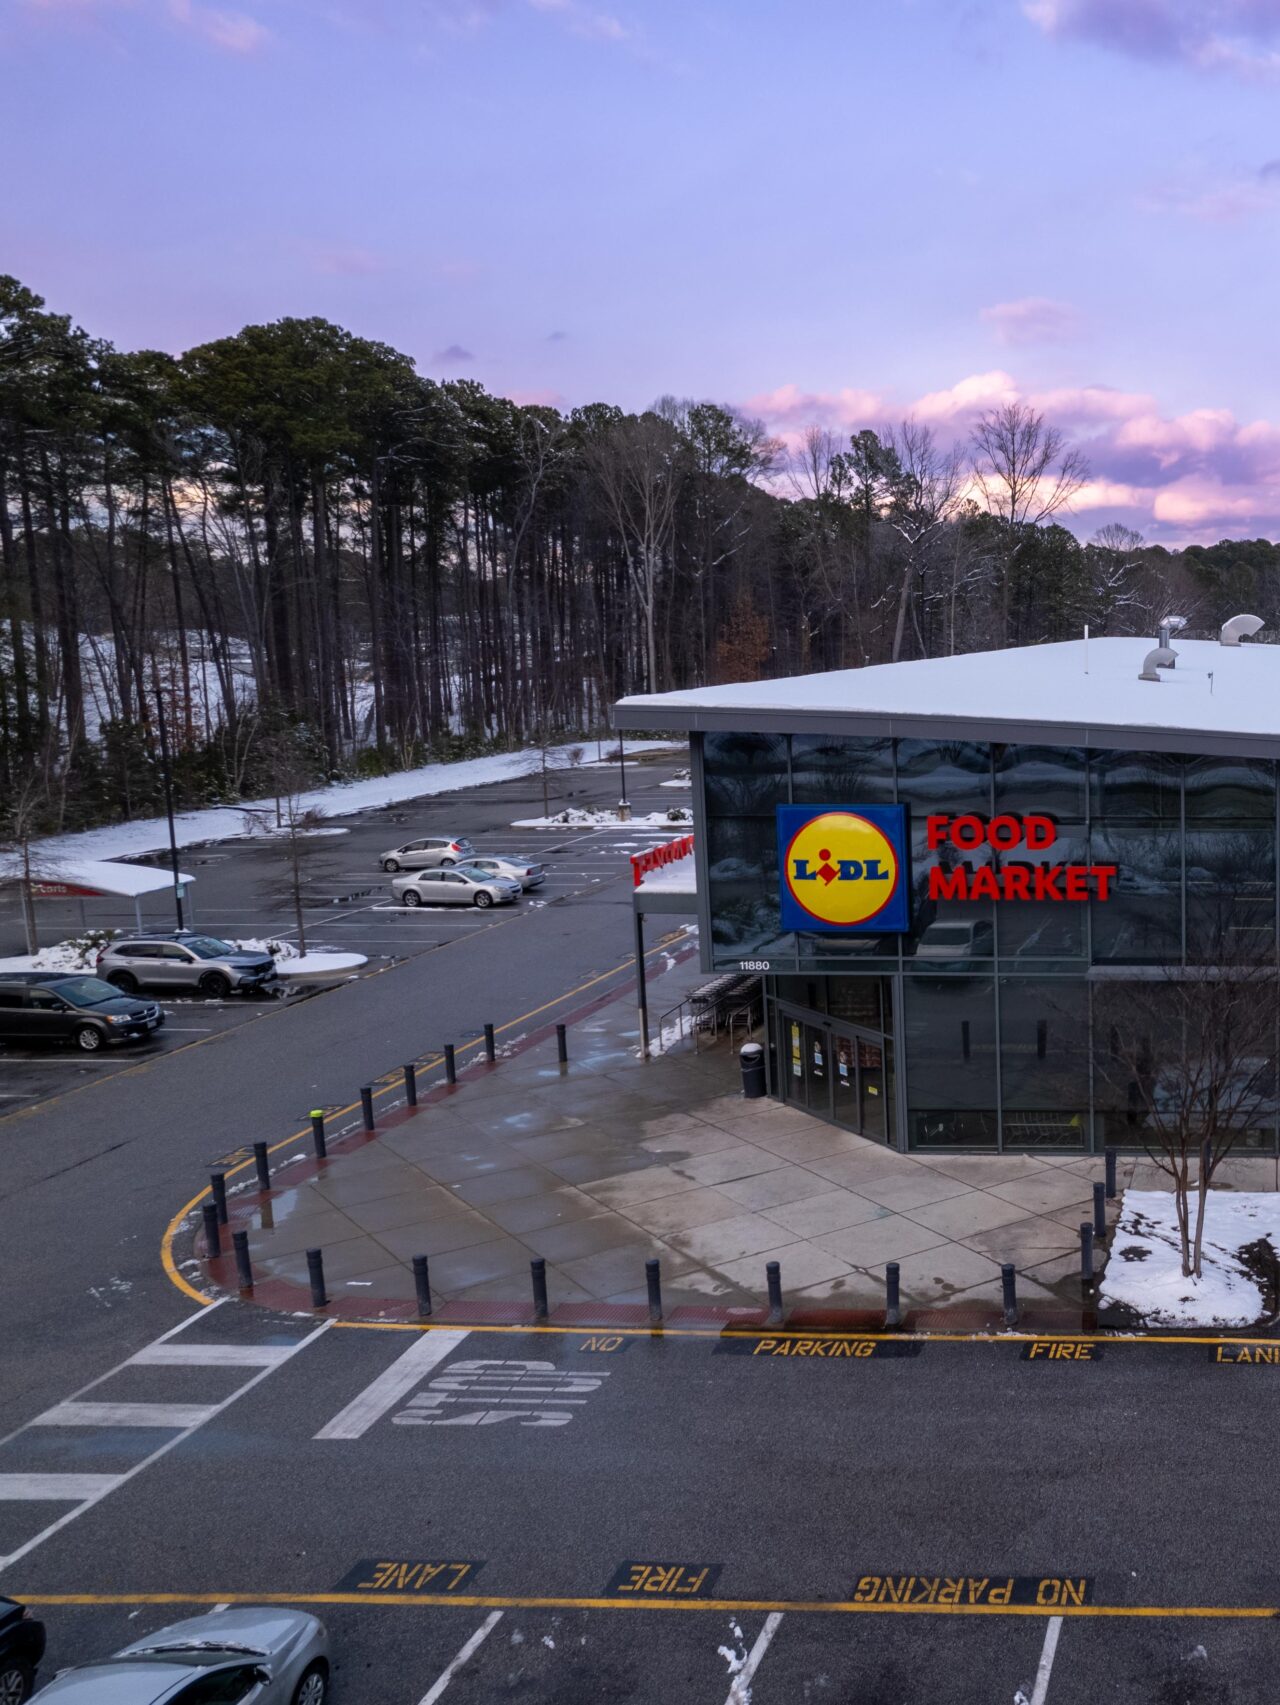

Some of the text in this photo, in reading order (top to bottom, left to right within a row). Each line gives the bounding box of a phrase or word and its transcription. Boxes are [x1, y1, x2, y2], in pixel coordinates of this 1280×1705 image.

[926, 815, 1057, 851] FOOD
[928, 865, 1117, 901] MARKET
[739, 960, 770, 971] 11880
[579, 1335, 623, 1353] NO
[752, 1339, 877, 1358] PARKING
[1029, 1342, 1096, 1361] FIRE
[391, 1359, 611, 1427] STOP
[357, 1561, 1087, 1605] NO PARKING FIRE LANE
